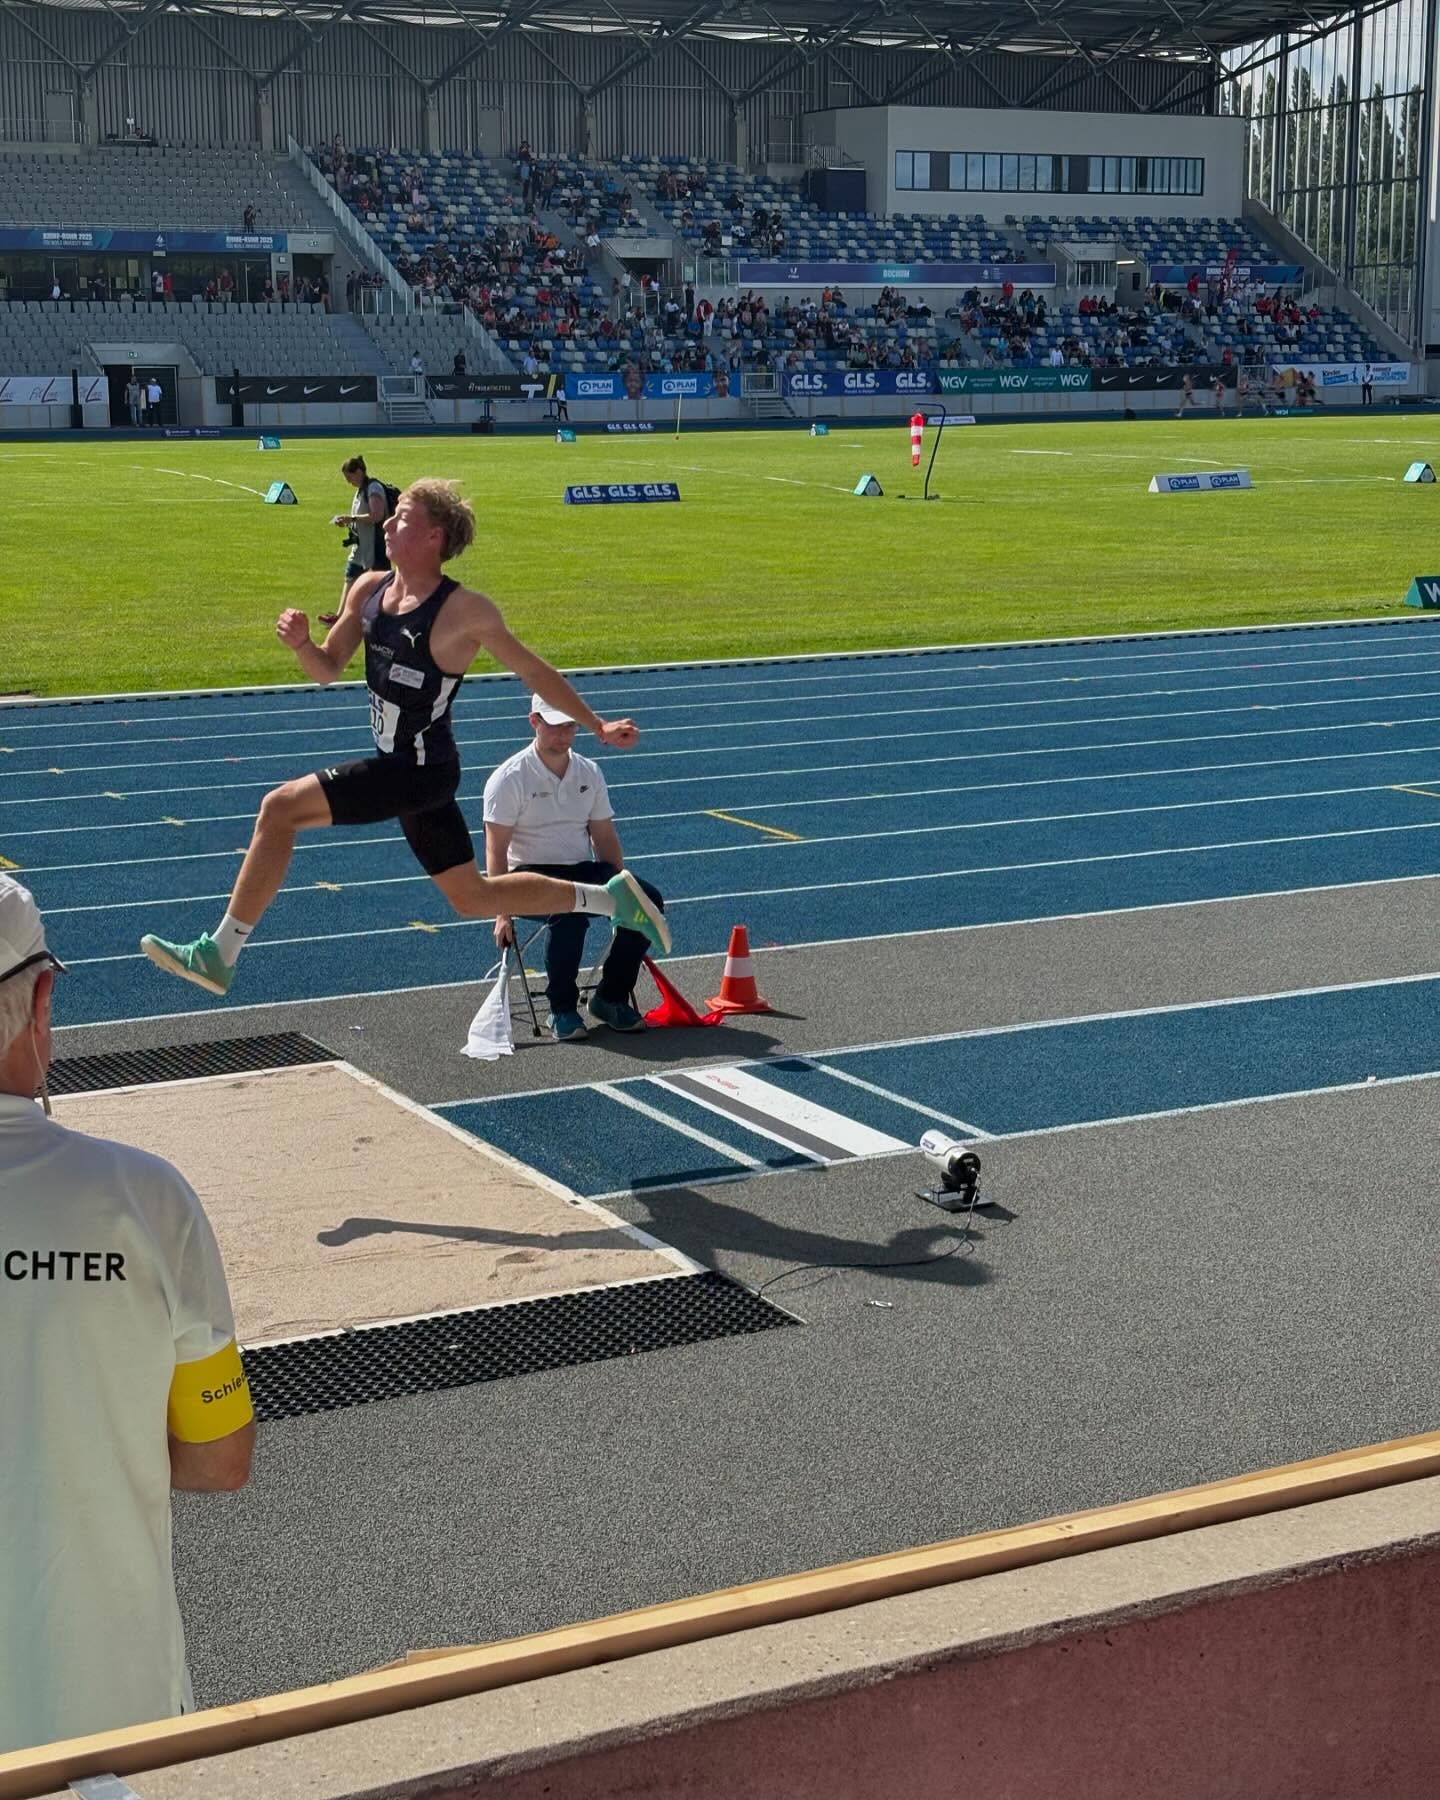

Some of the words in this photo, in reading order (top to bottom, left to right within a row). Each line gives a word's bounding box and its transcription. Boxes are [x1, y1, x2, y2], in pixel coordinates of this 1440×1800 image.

[592, 381, 612, 390] PLAN
[676, 380, 697, 390] PLAN
[938, 375, 968, 389] WGV
[999, 374, 1029, 388] WGV
[1060, 373, 1089, 387] WGV
[4, 1250, 127, 1282] CHTER
